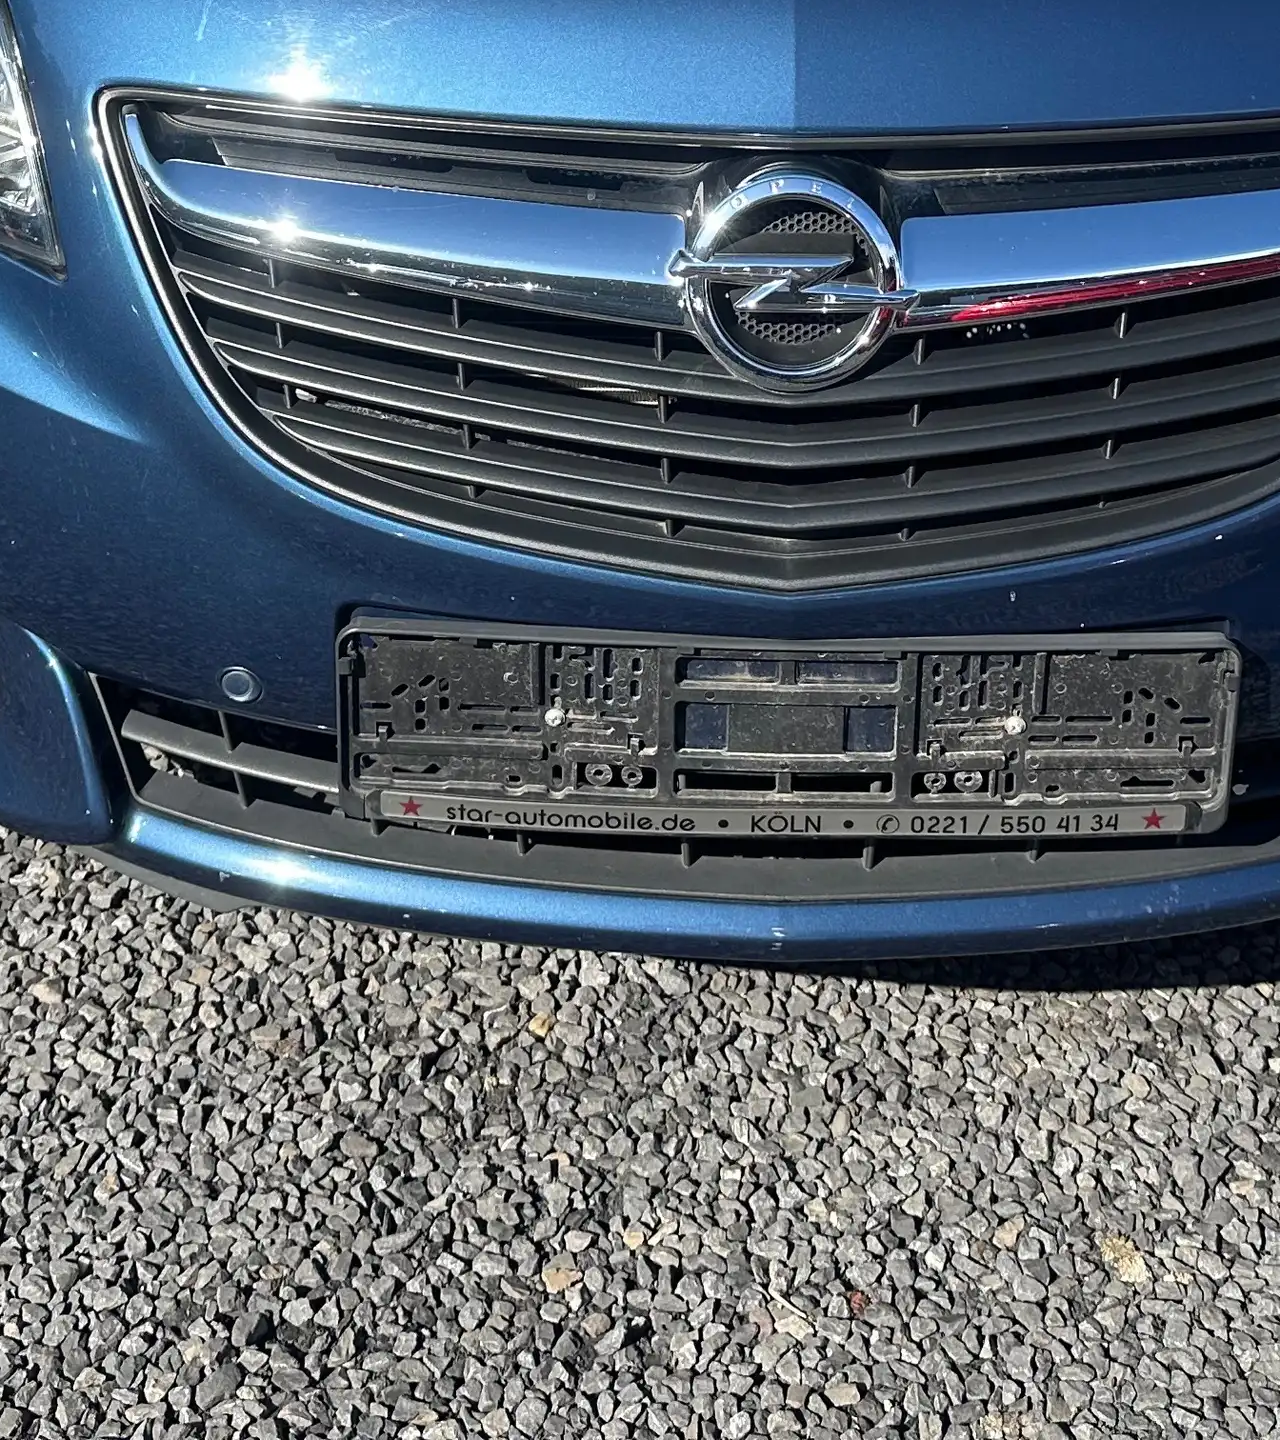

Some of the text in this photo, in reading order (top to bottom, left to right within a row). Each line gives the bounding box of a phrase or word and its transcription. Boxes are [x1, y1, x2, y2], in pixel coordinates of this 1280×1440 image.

[729, 178, 856, 210] OPEL
[446, 804, 696, 832] star-automobile.de
[750, 809, 822, 834] KÖLN
[910, 815, 968, 834] 0221
[999, 815, 1046, 834] 550
[1056, 814, 1082, 833] 41
[1089, 813, 1120, 832] 34
